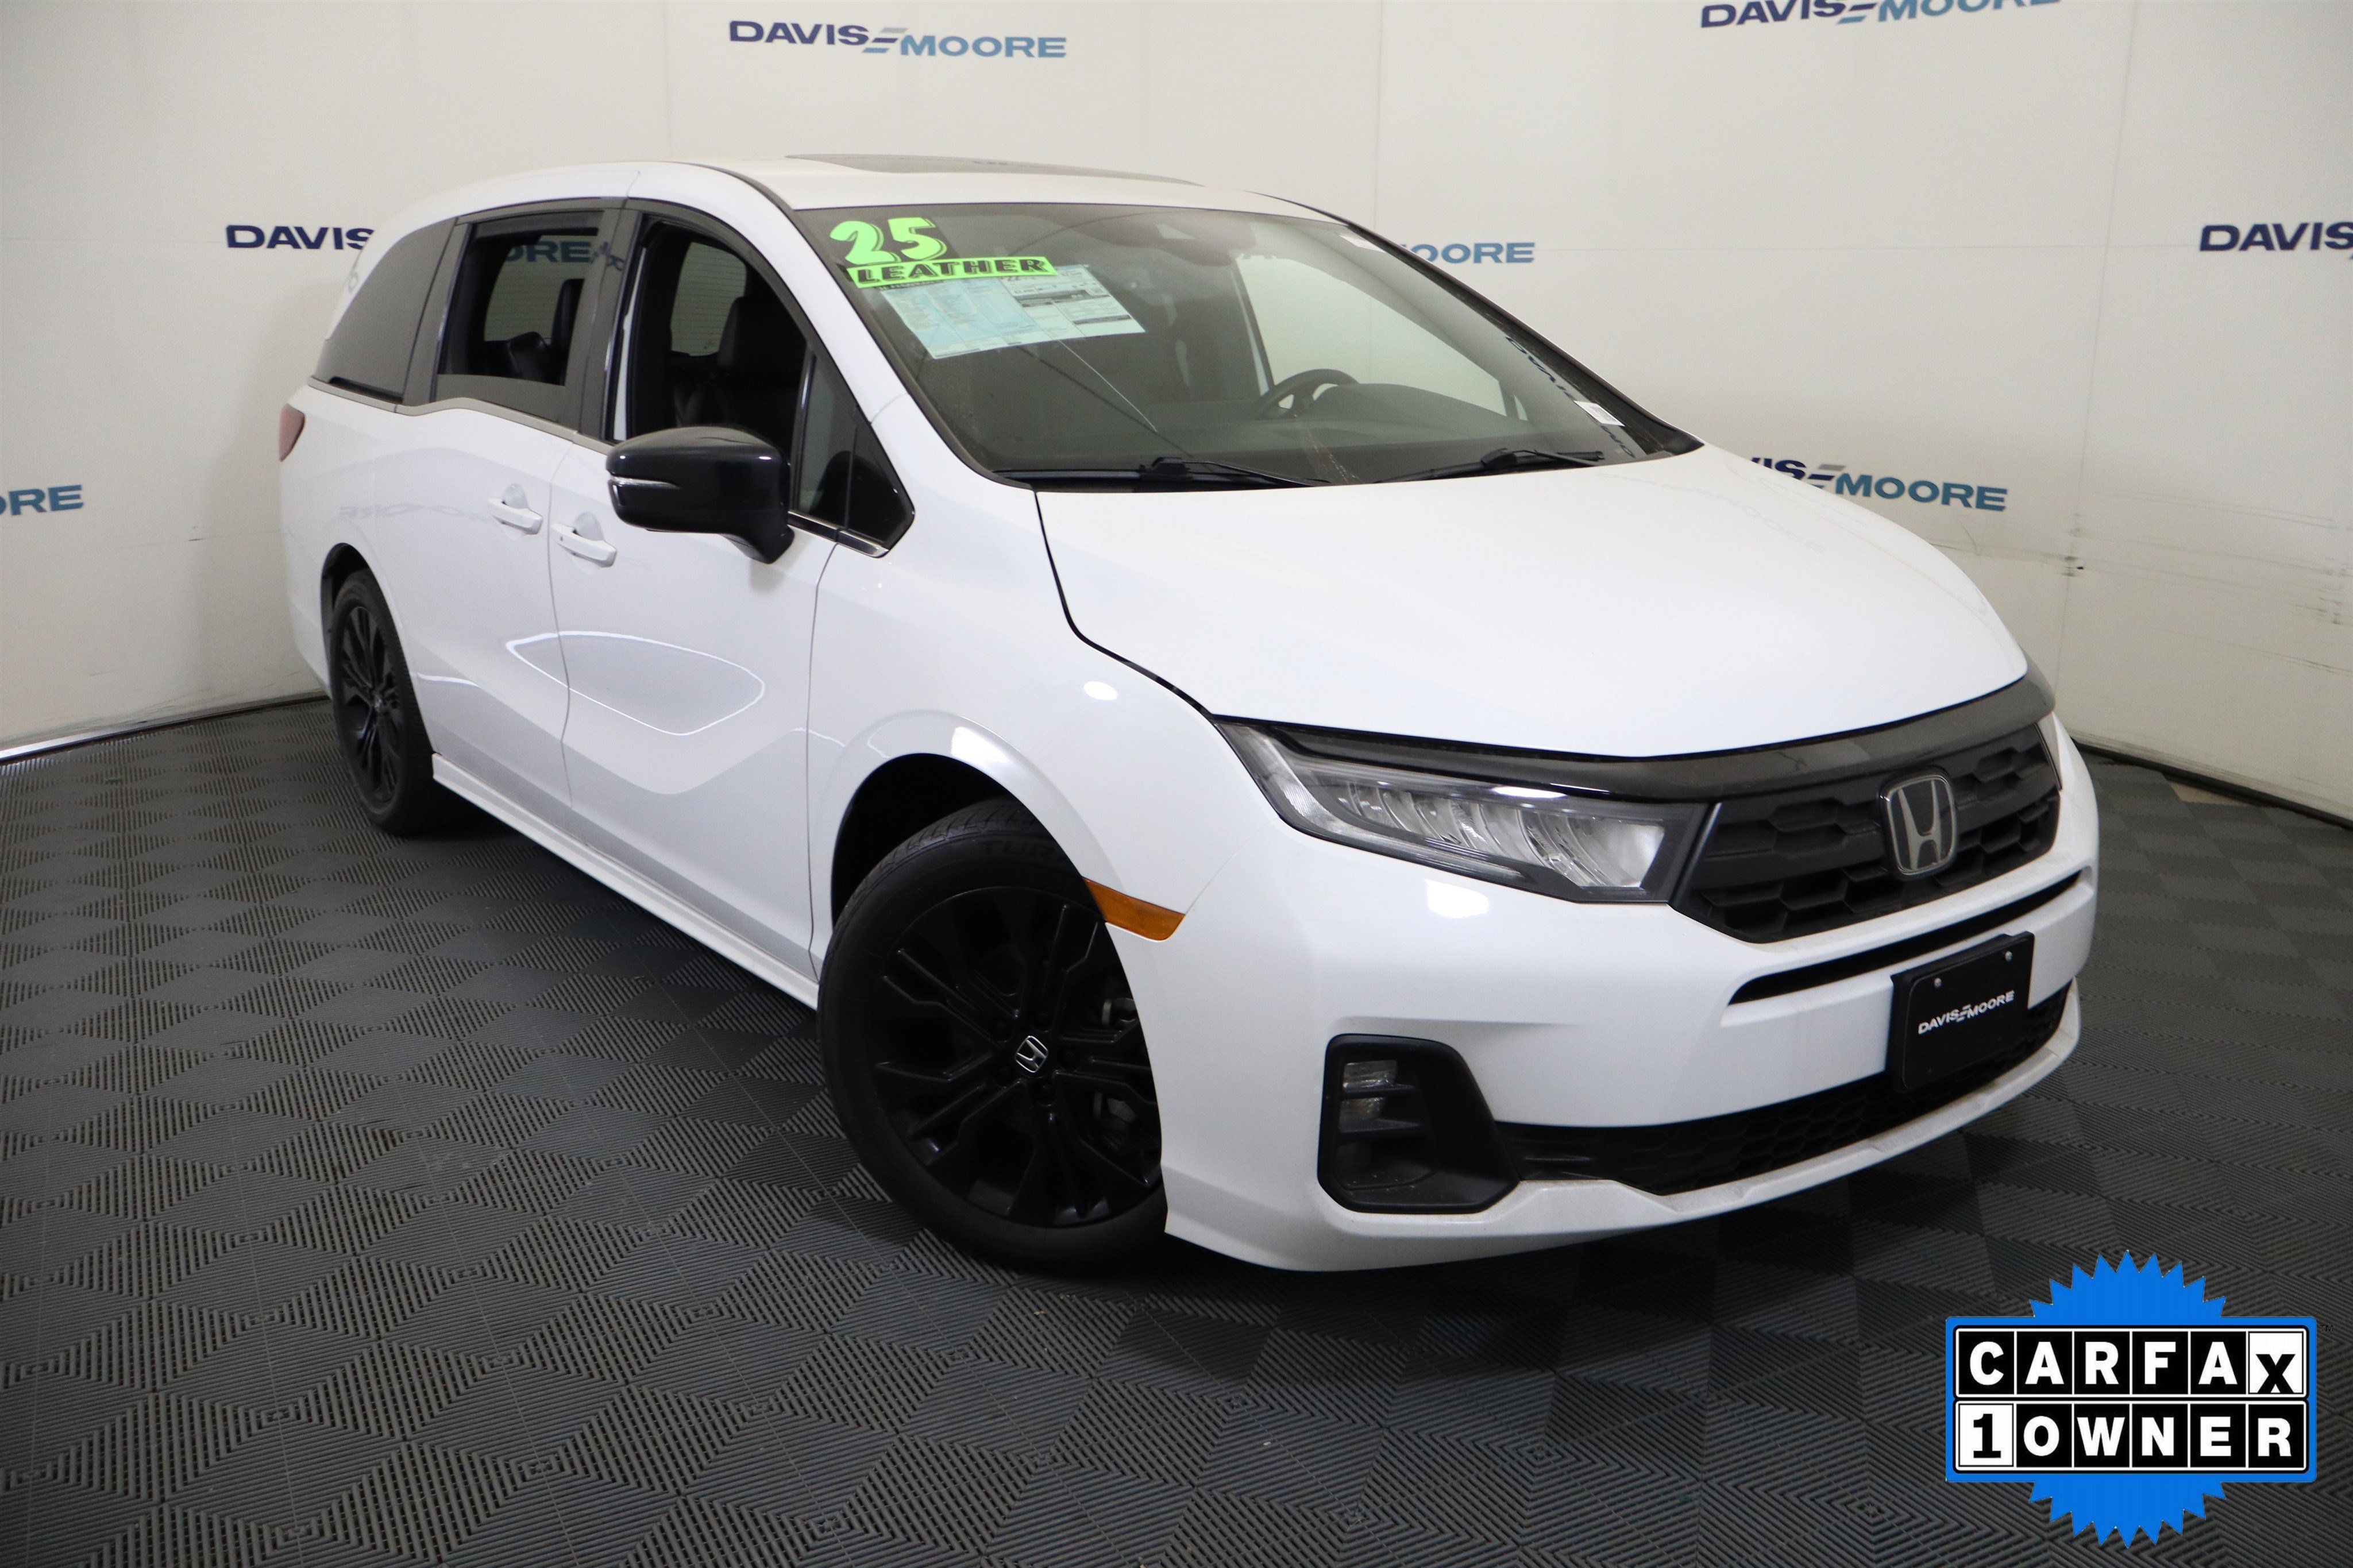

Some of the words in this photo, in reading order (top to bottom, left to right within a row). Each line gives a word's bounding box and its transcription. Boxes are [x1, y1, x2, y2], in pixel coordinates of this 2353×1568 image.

[1701, 0, 1846, 28] DAVIS
[730, 21, 869, 45] DAVIS
[900, 35, 1066, 57] MOORE
[226, 225, 375, 250] DAVIS
[830, 217, 947, 265] 25
[2200, 222, 2353, 252] DAVIS
[1401, 242, 1534, 263] OORE
[858, 258, 1051, 284] LEATHER
[0, 484, 84, 515] RE
[1835, 473, 2008, 512] MOORE
[1918, 1009, 1959, 1034] DAVIS
[1967, 990, 2015, 1019] MOORE
